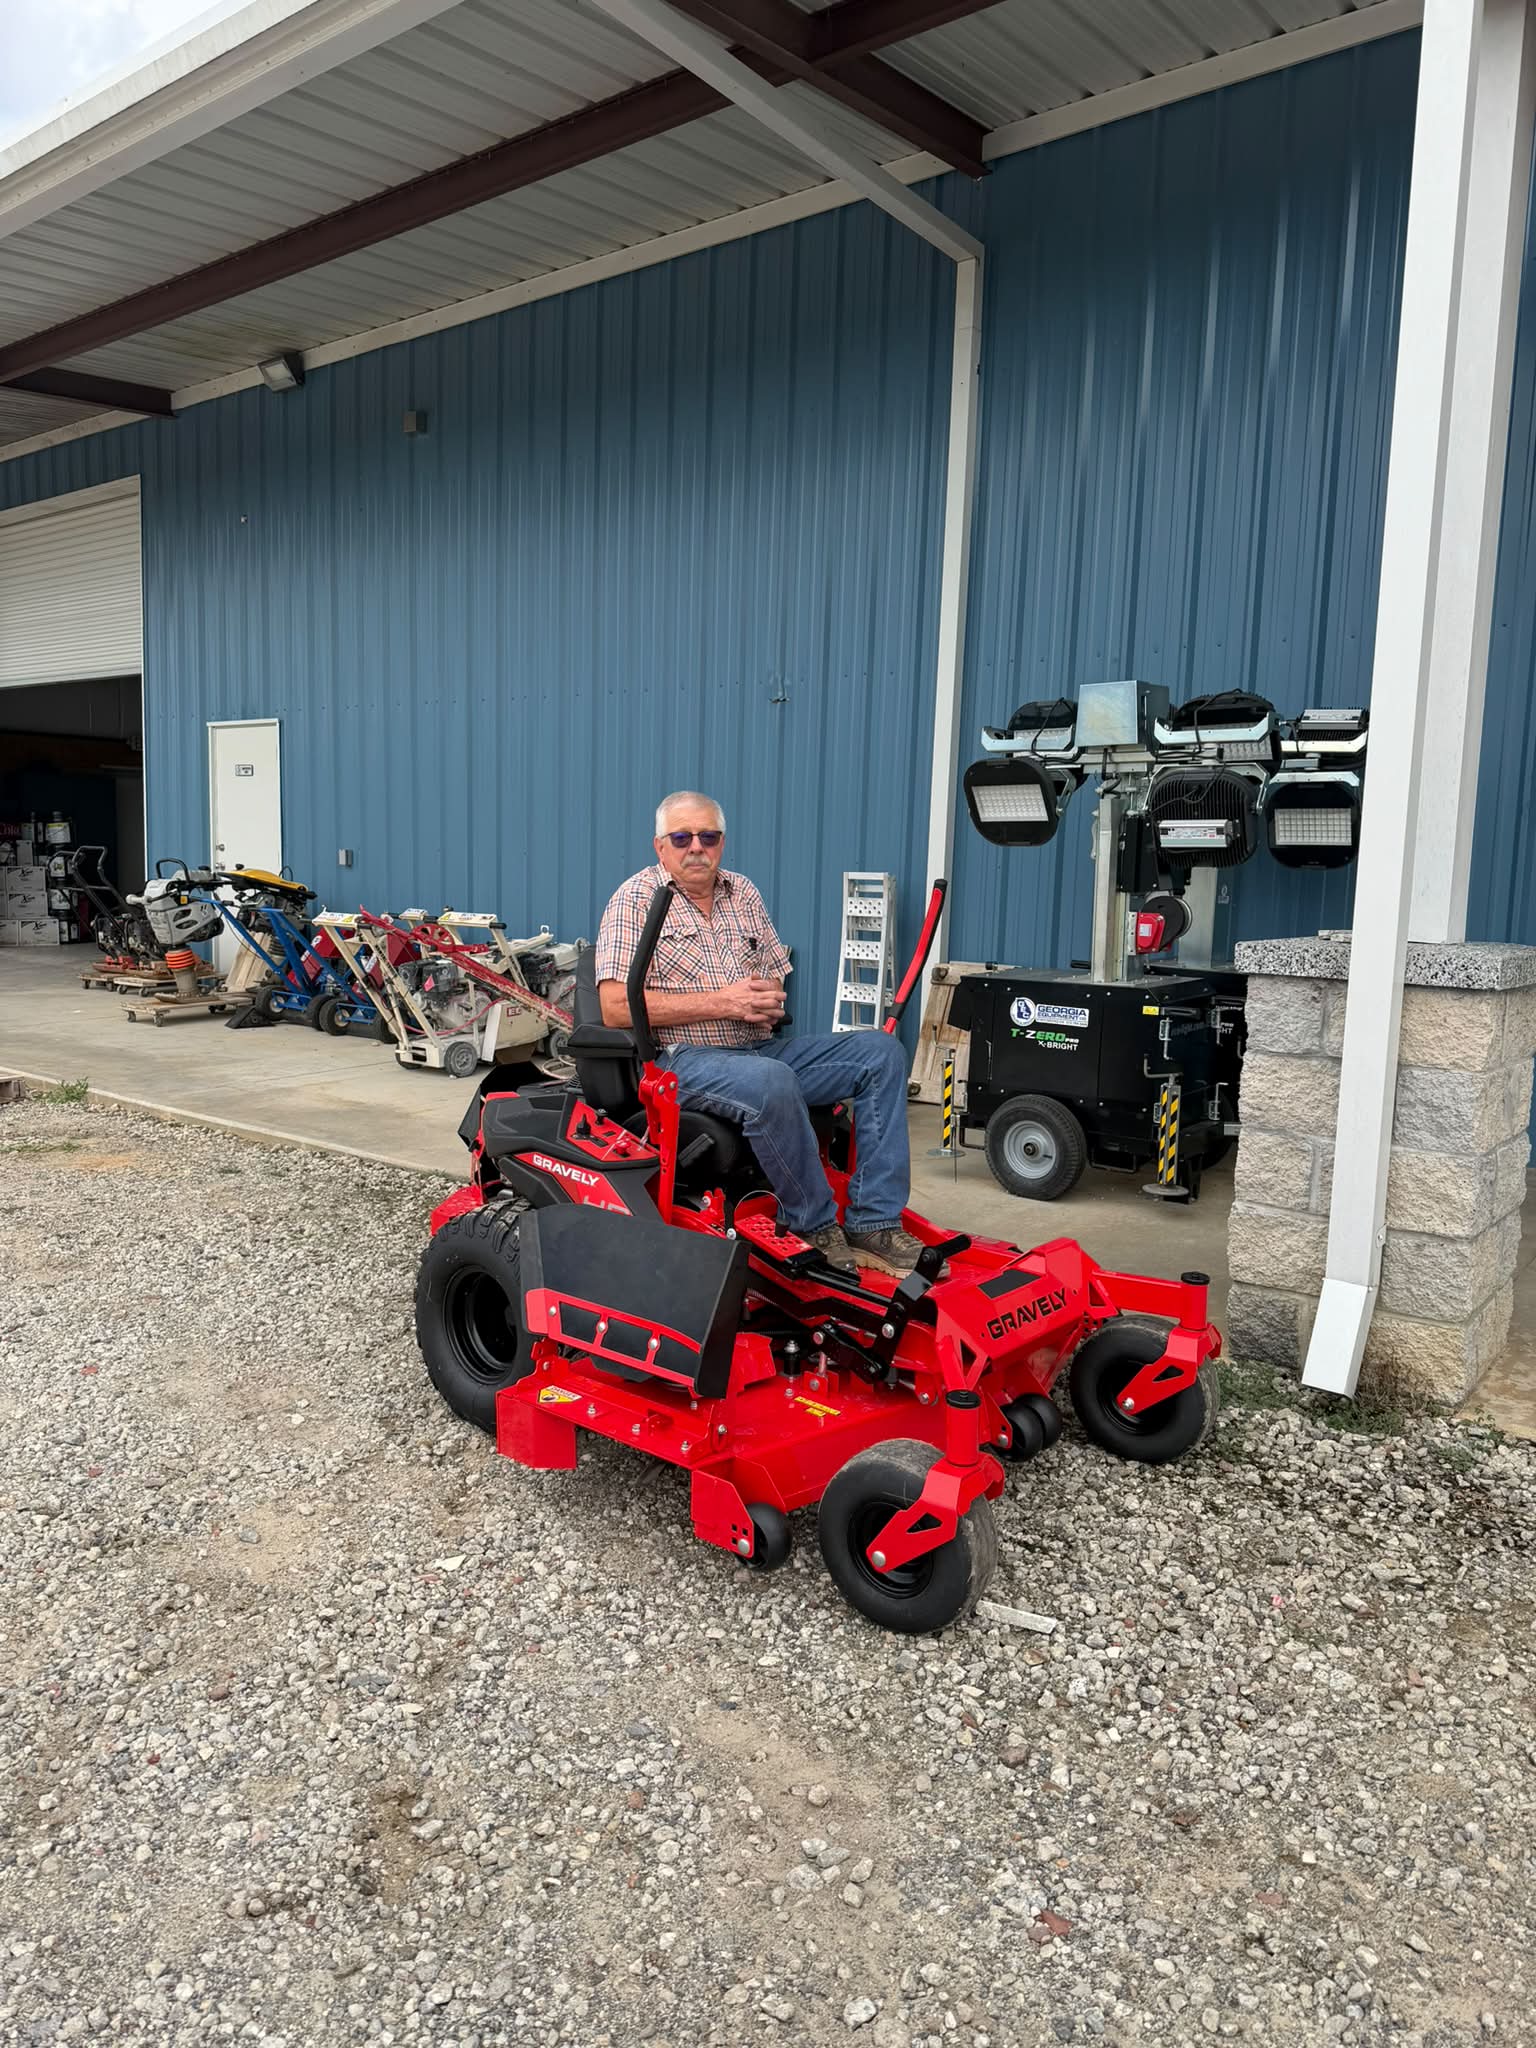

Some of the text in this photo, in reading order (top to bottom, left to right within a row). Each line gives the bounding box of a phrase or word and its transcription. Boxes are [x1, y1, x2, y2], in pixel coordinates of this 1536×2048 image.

[1037, 1005, 1087, 1017] GEORGIA
[533, 1154, 600, 1186] GRAVELY
[987, 1288, 1067, 1339] GRAVELY
